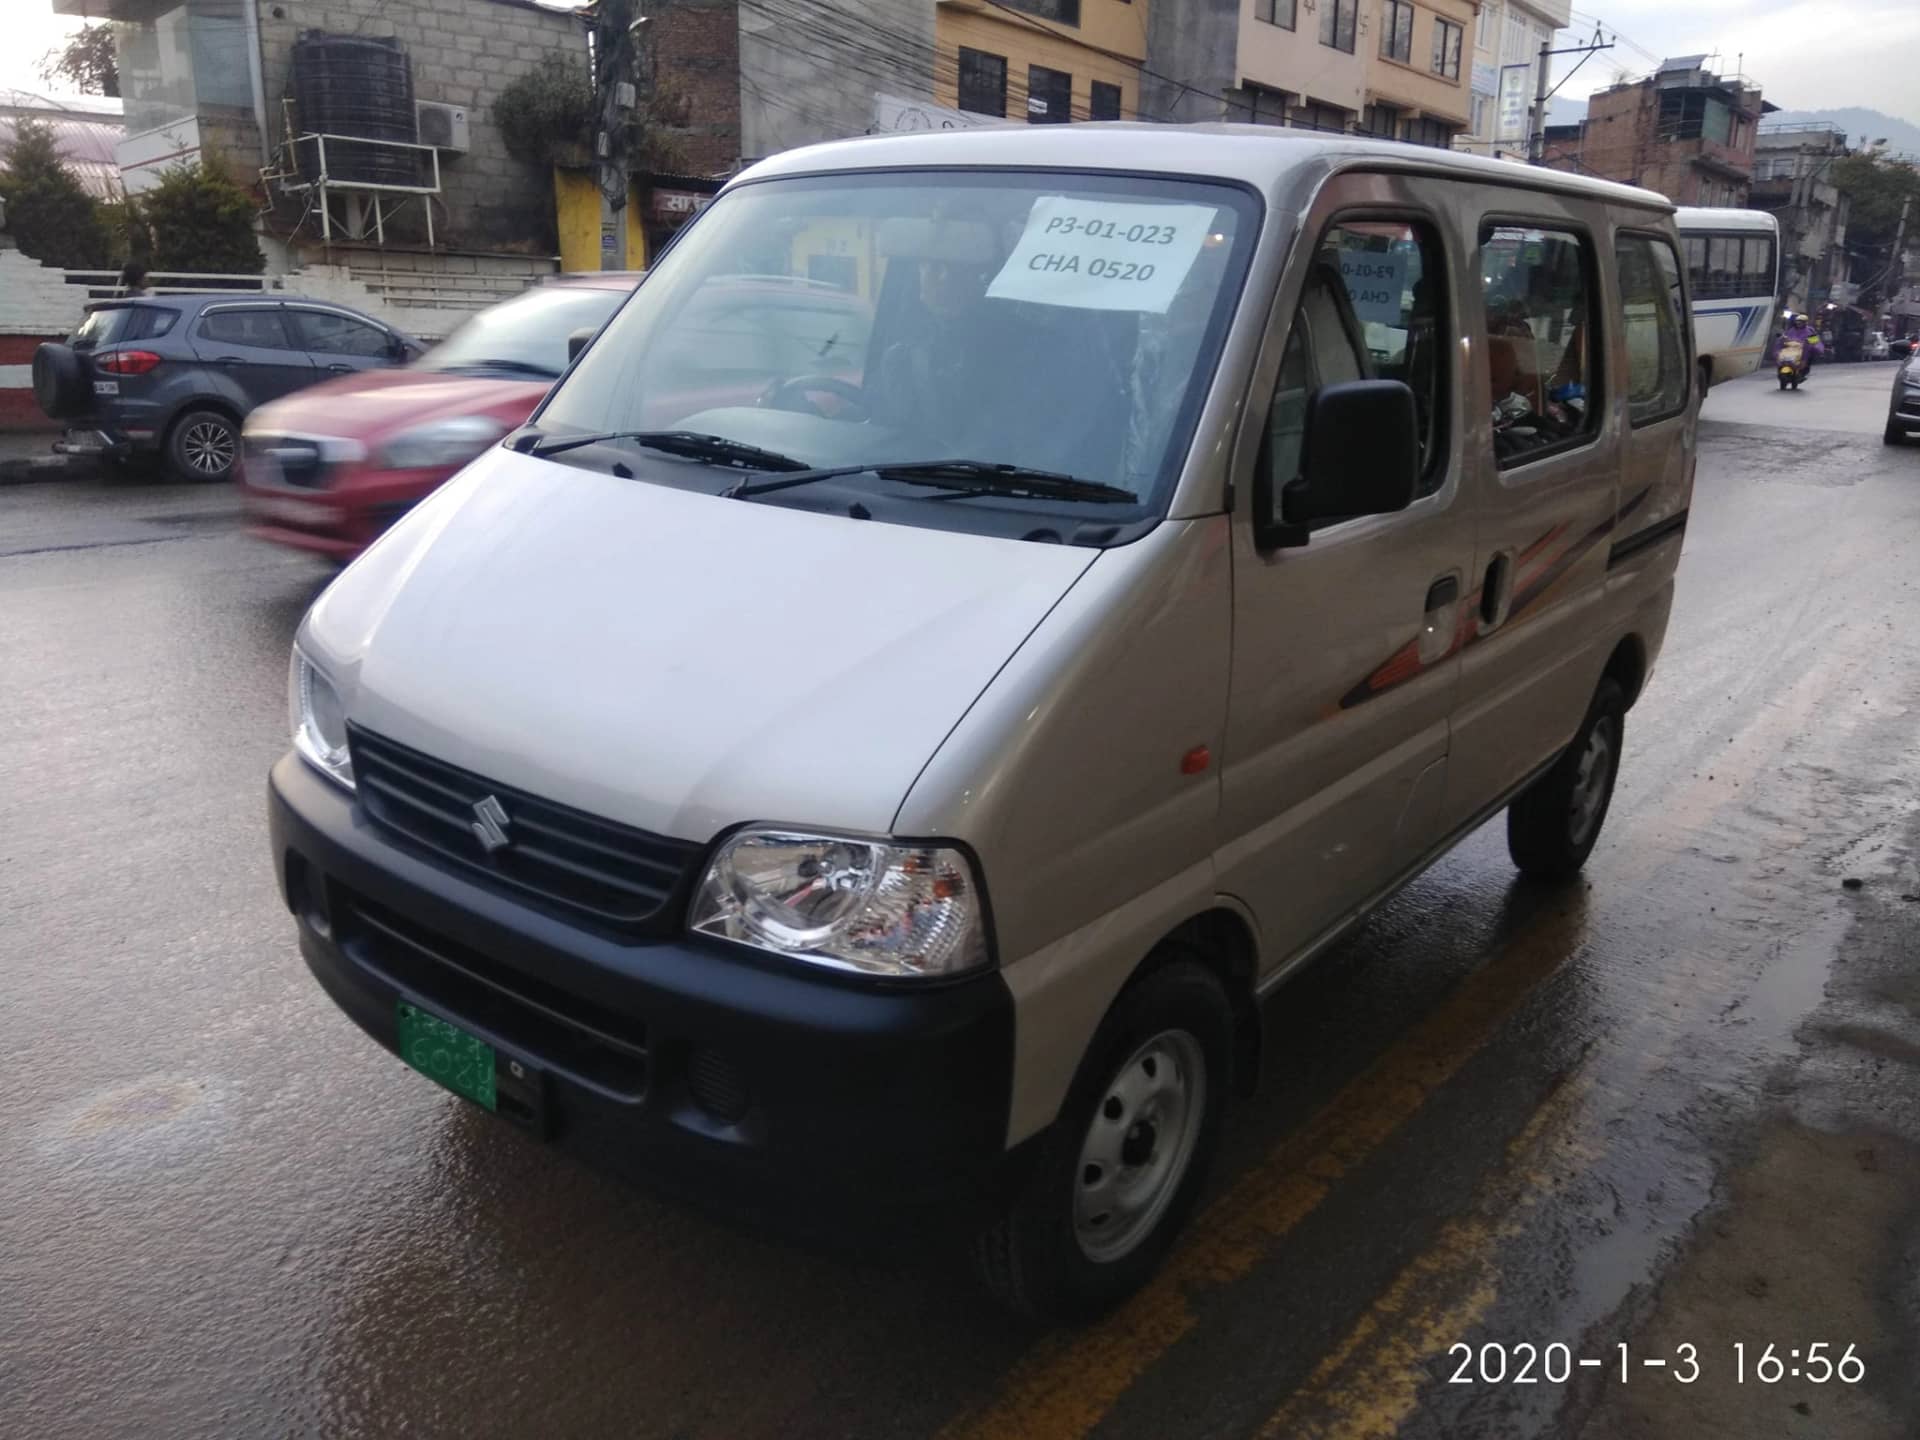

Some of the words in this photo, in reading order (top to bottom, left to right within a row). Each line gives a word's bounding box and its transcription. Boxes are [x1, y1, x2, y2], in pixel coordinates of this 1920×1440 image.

[1046, 216, 1177, 246] P3-01-023
[1028, 253, 1080, 274] CHA
[1087, 258, 1156, 282] 0520
